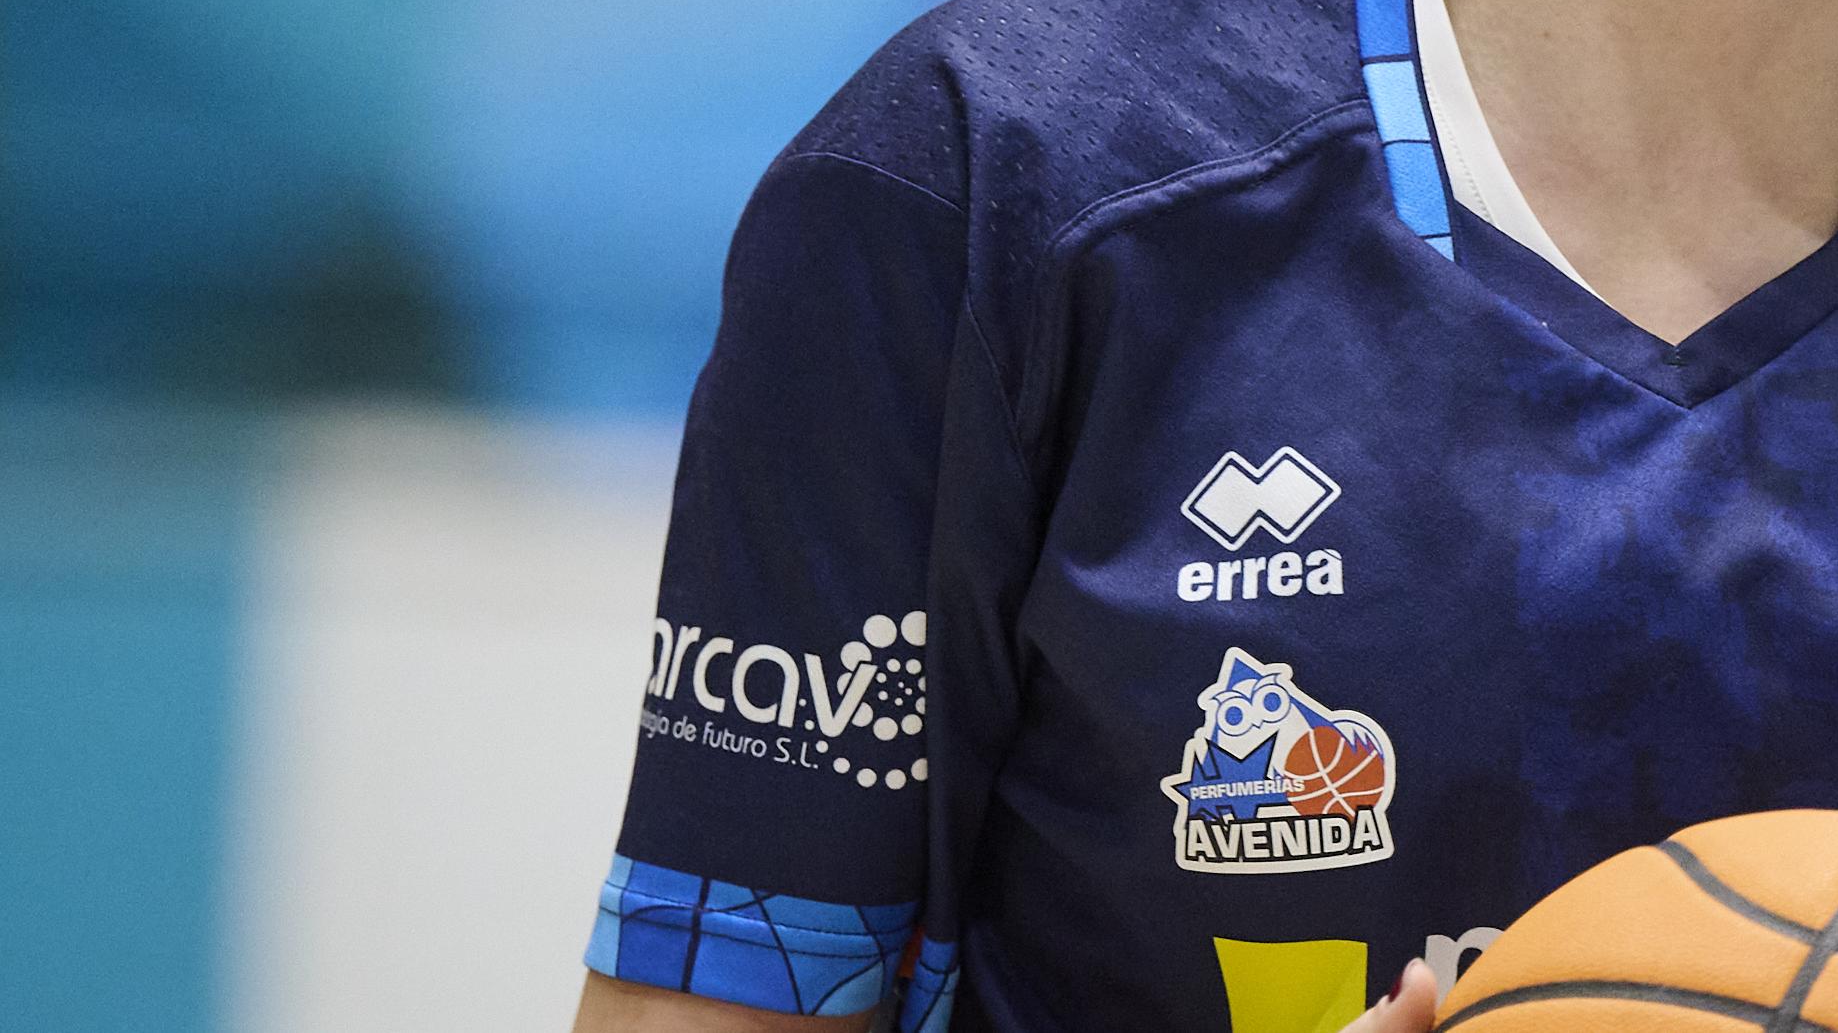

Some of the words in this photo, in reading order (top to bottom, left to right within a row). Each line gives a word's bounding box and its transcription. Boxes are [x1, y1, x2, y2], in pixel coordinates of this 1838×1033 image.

[672, 715, 697, 742] de
[702, 721, 767, 758] futuro
[1189, 777, 1306, 800] PERFUMERÍAS
[1187, 809, 1382, 860] AVENIDA
